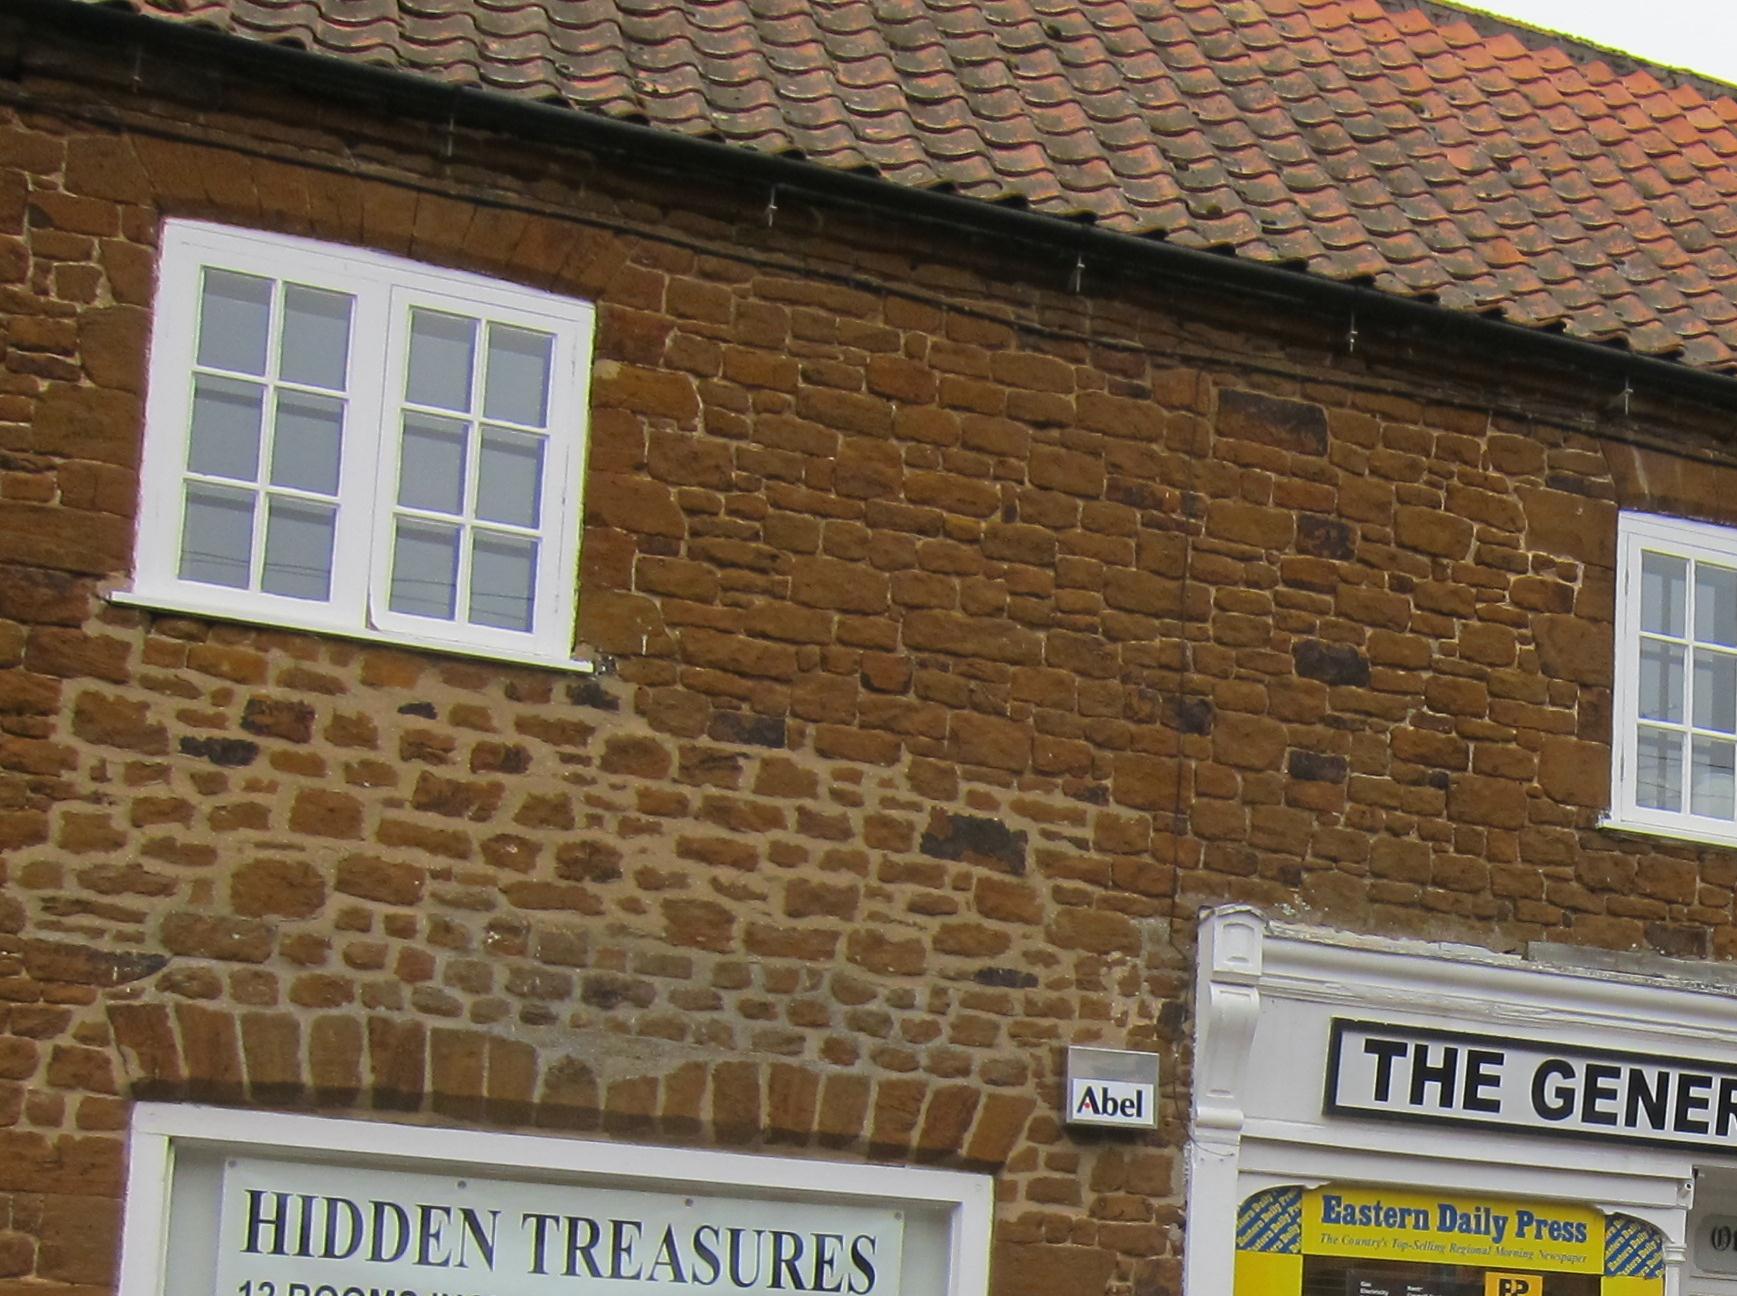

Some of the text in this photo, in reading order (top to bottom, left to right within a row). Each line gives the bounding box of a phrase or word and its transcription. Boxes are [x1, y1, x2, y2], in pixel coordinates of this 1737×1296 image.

[1364, 1038, 1504, 1113] THE
[1076, 1085, 1143, 1118] Abel
[240, 1189, 876, 1295] HIDDEN TREASURES
[1322, 1194, 1587, 1244] Eastern Daily Press
[1320, 1233, 1338, 1245] The
[1449, 1242, 1491, 1257] Regional
